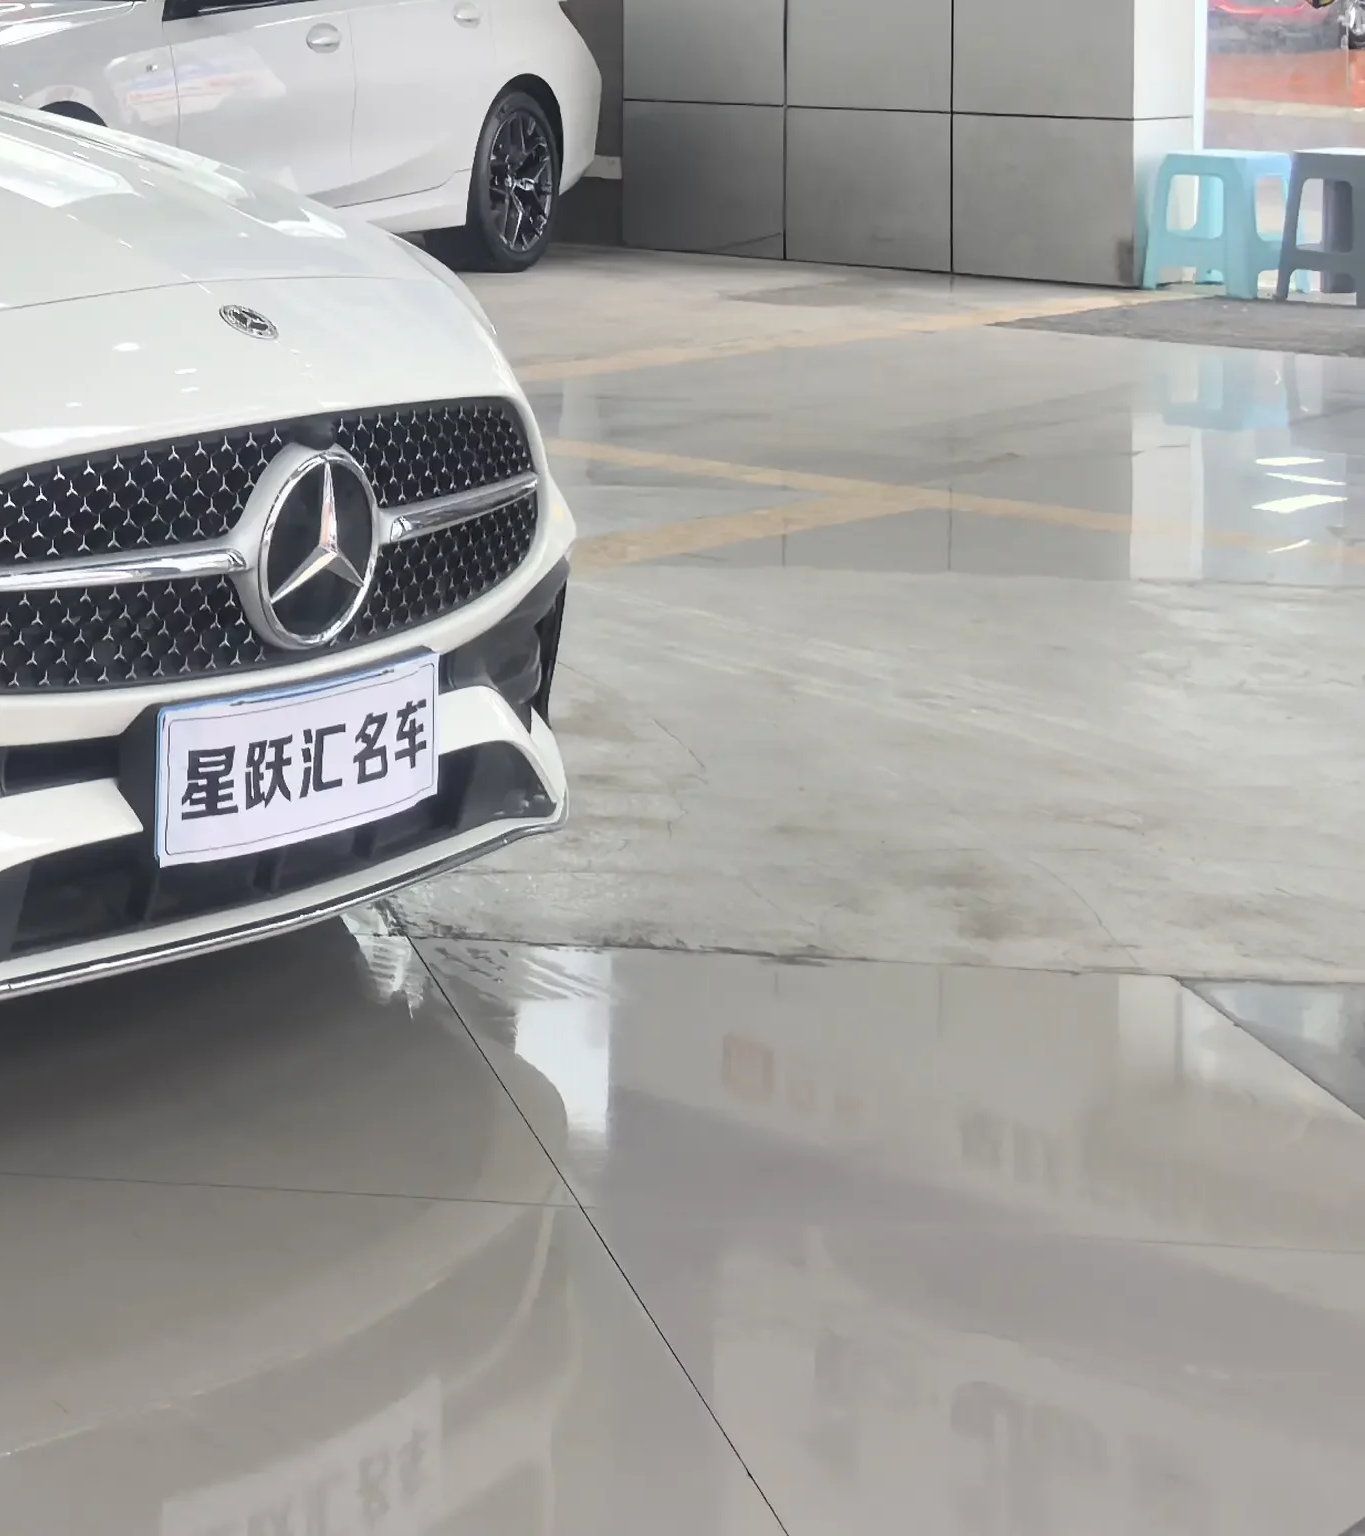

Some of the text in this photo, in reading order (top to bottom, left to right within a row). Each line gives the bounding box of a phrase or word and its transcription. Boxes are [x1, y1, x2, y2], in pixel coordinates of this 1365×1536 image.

[181, 698, 427, 821] 星跃汇名车
